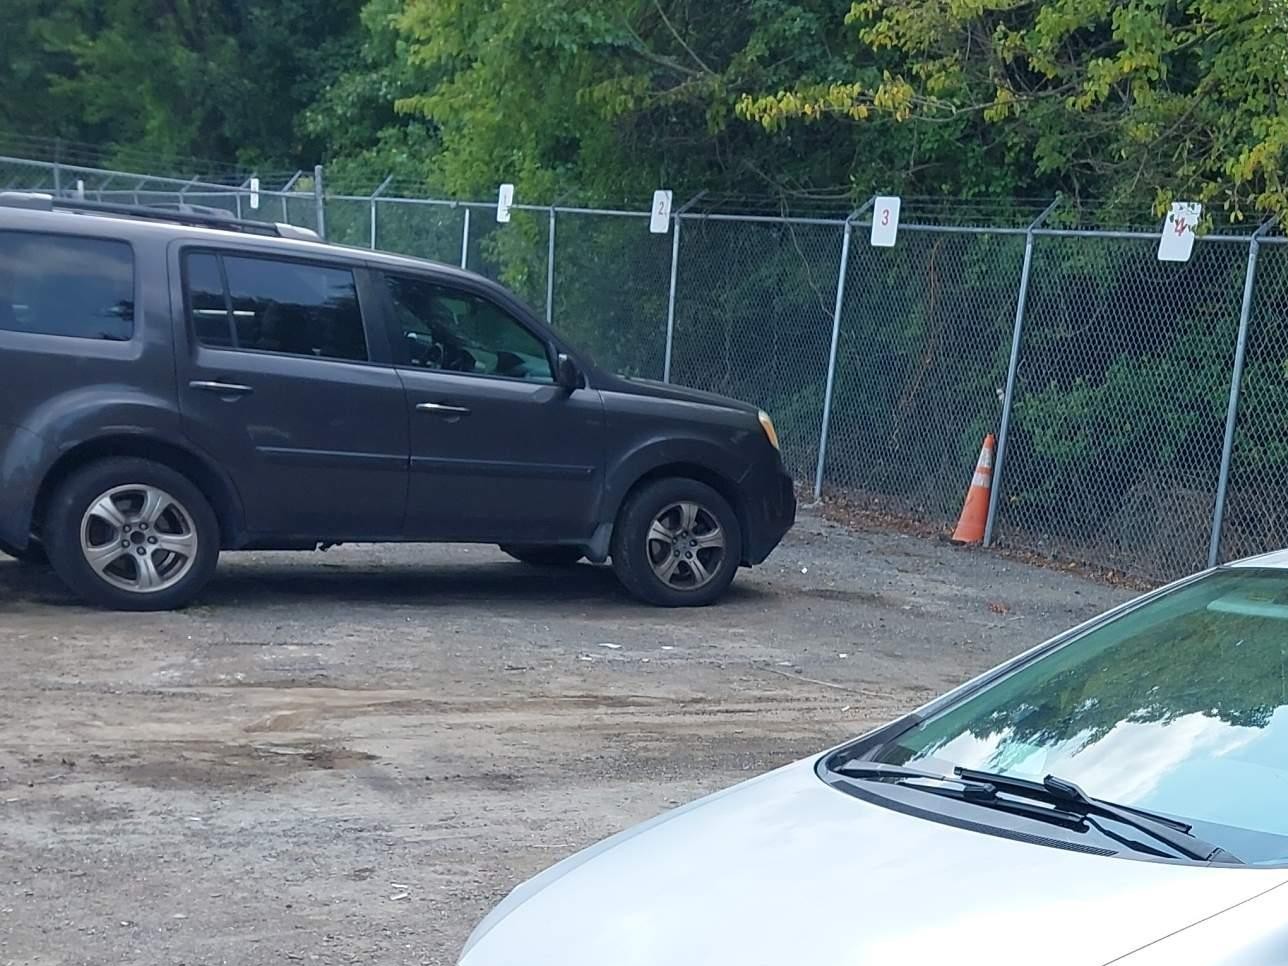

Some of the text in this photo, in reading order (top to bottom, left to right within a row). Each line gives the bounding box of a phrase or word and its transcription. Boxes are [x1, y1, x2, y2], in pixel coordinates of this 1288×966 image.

[658, 201, 665, 216] 2
[881, 209, 890, 226] 3
[1174, 217, 1186, 236] 4
